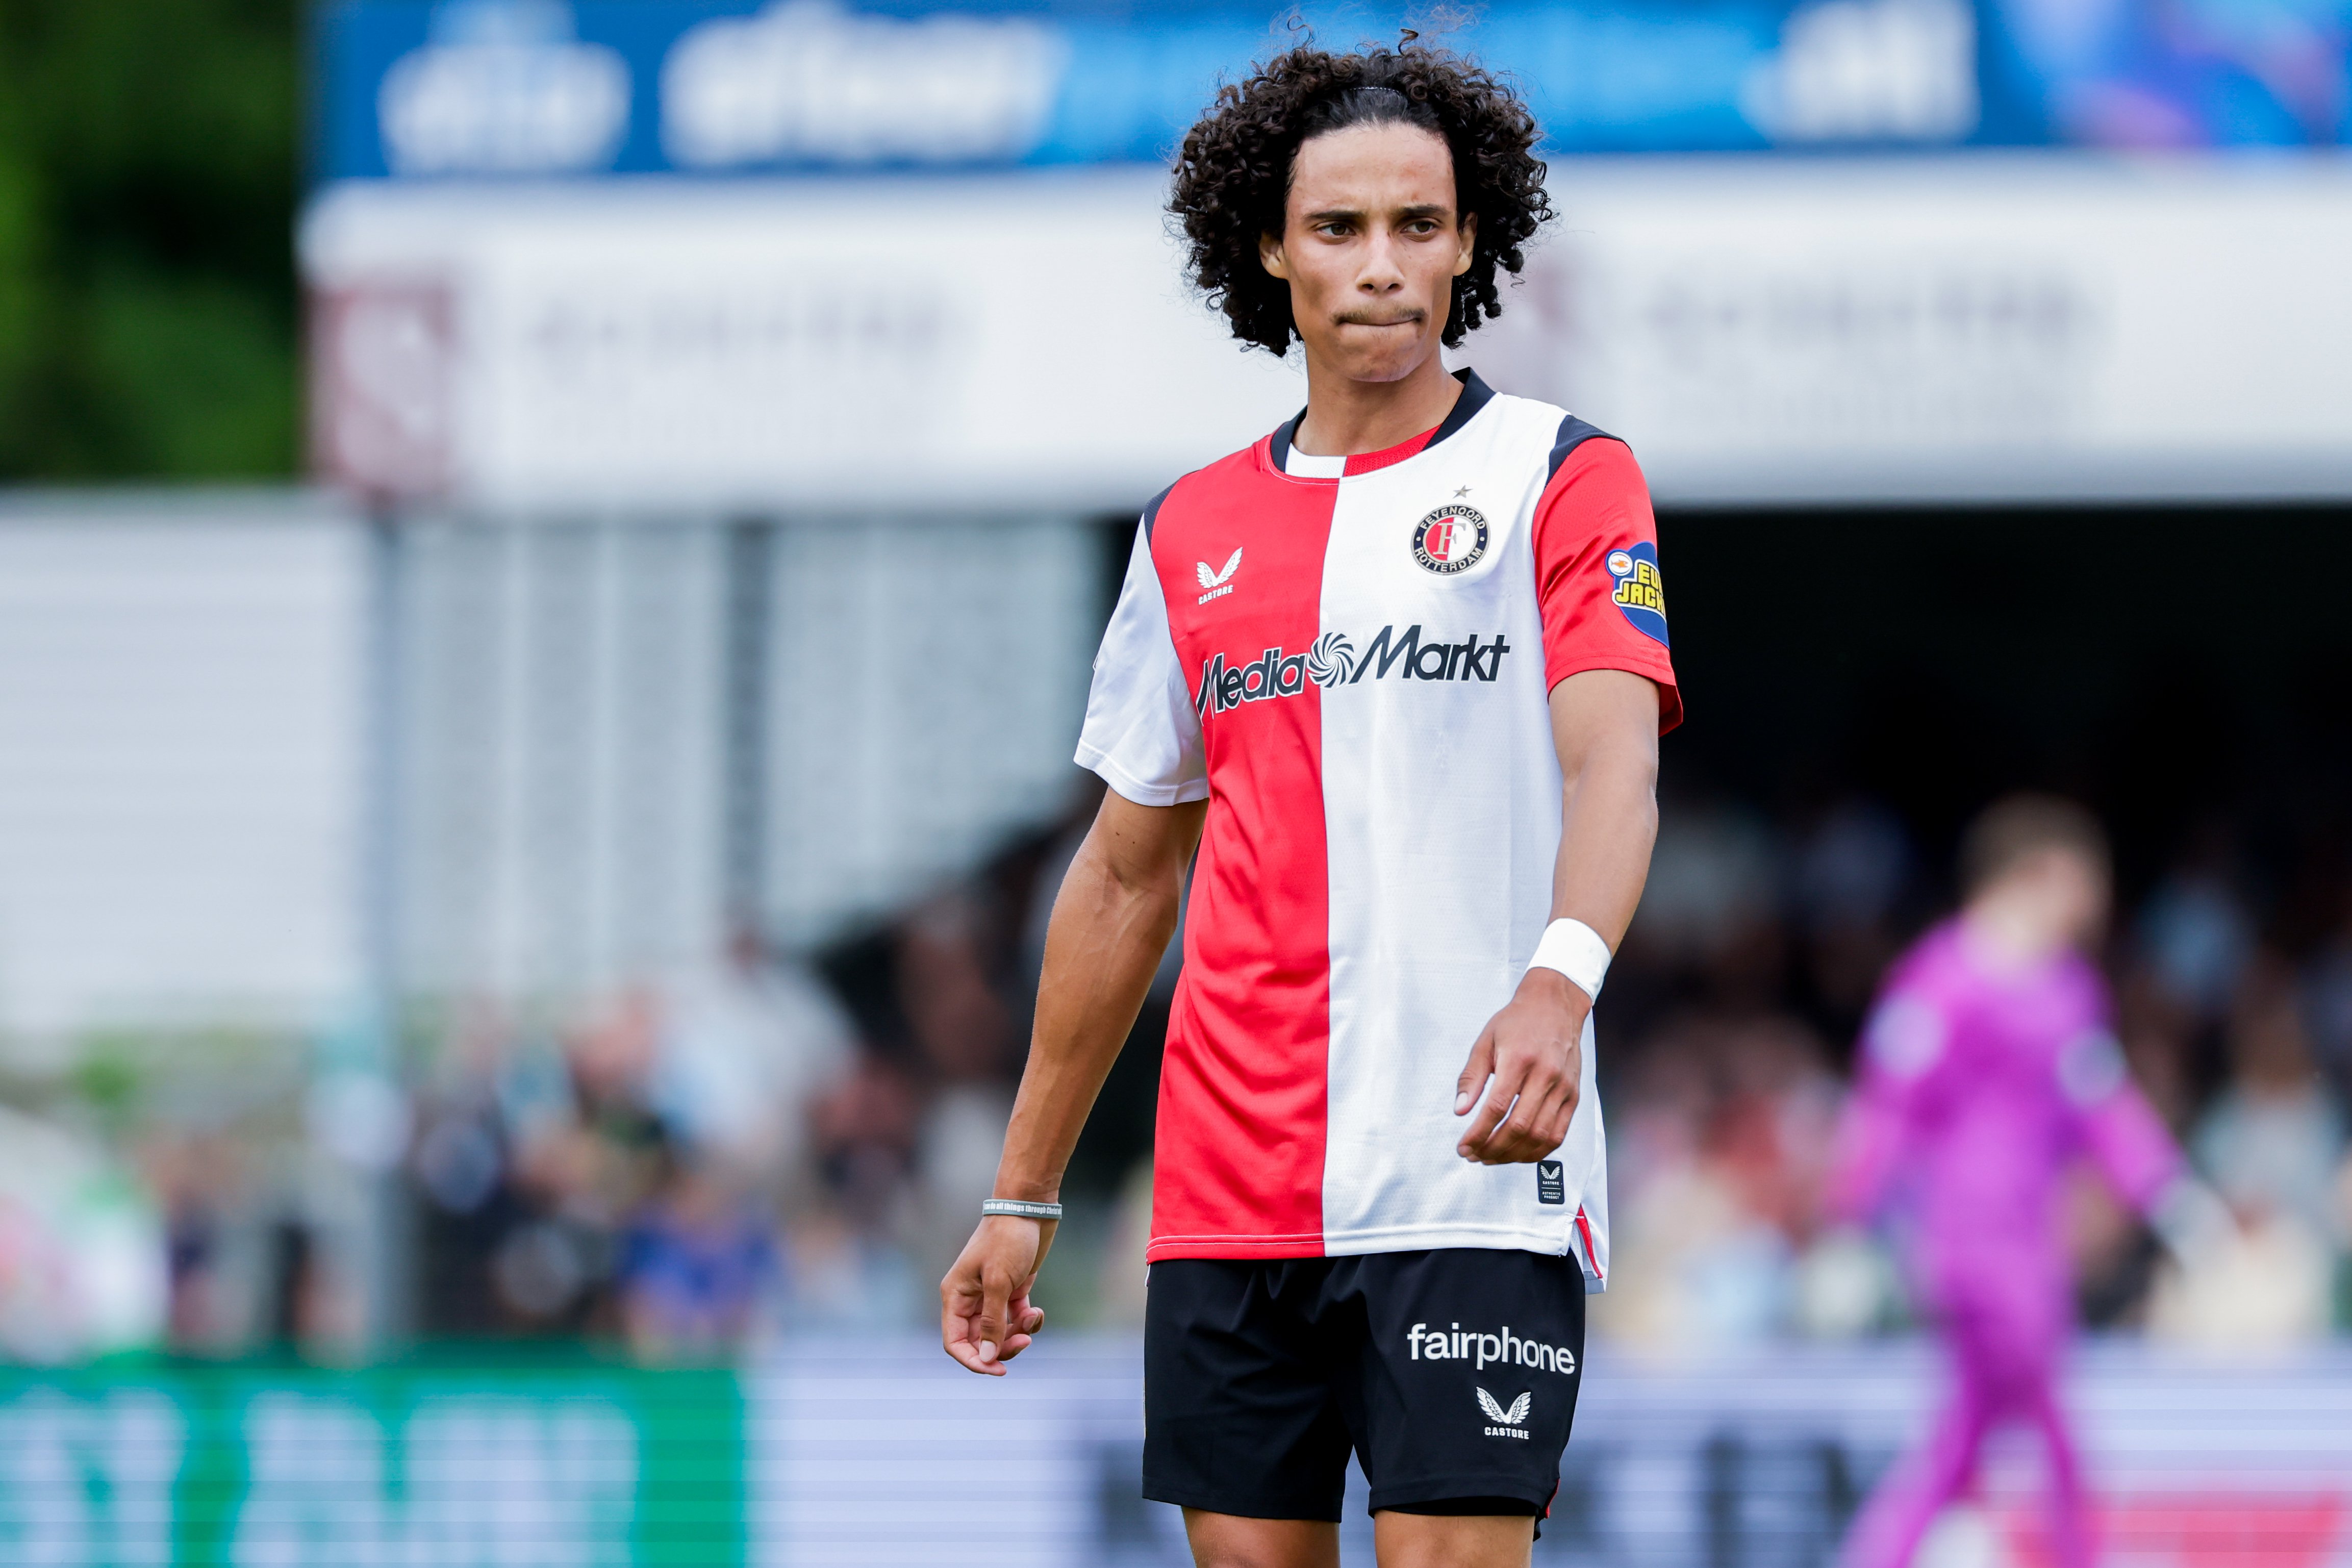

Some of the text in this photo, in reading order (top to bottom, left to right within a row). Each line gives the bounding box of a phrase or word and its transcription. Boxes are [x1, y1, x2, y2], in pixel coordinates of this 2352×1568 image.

[1420, 507, 1485, 529] FEYENOORD
[1433, 522, 1466, 555] F
[1414, 547, 1483, 572] ROTTERDAM
[1198, 585, 1233, 605] CASTORE
[1615, 582, 1666, 617] JACK
[1196, 624, 1510, 722] Media Markt
[1004, 1202, 1025, 1212] things
[1025, 1204, 1046, 1215] through
[1046, 1206, 1058, 1215] Christ
[1407, 1322, 1575, 1375] fairphone
[1484, 1427, 1529, 1440] CASTORE
